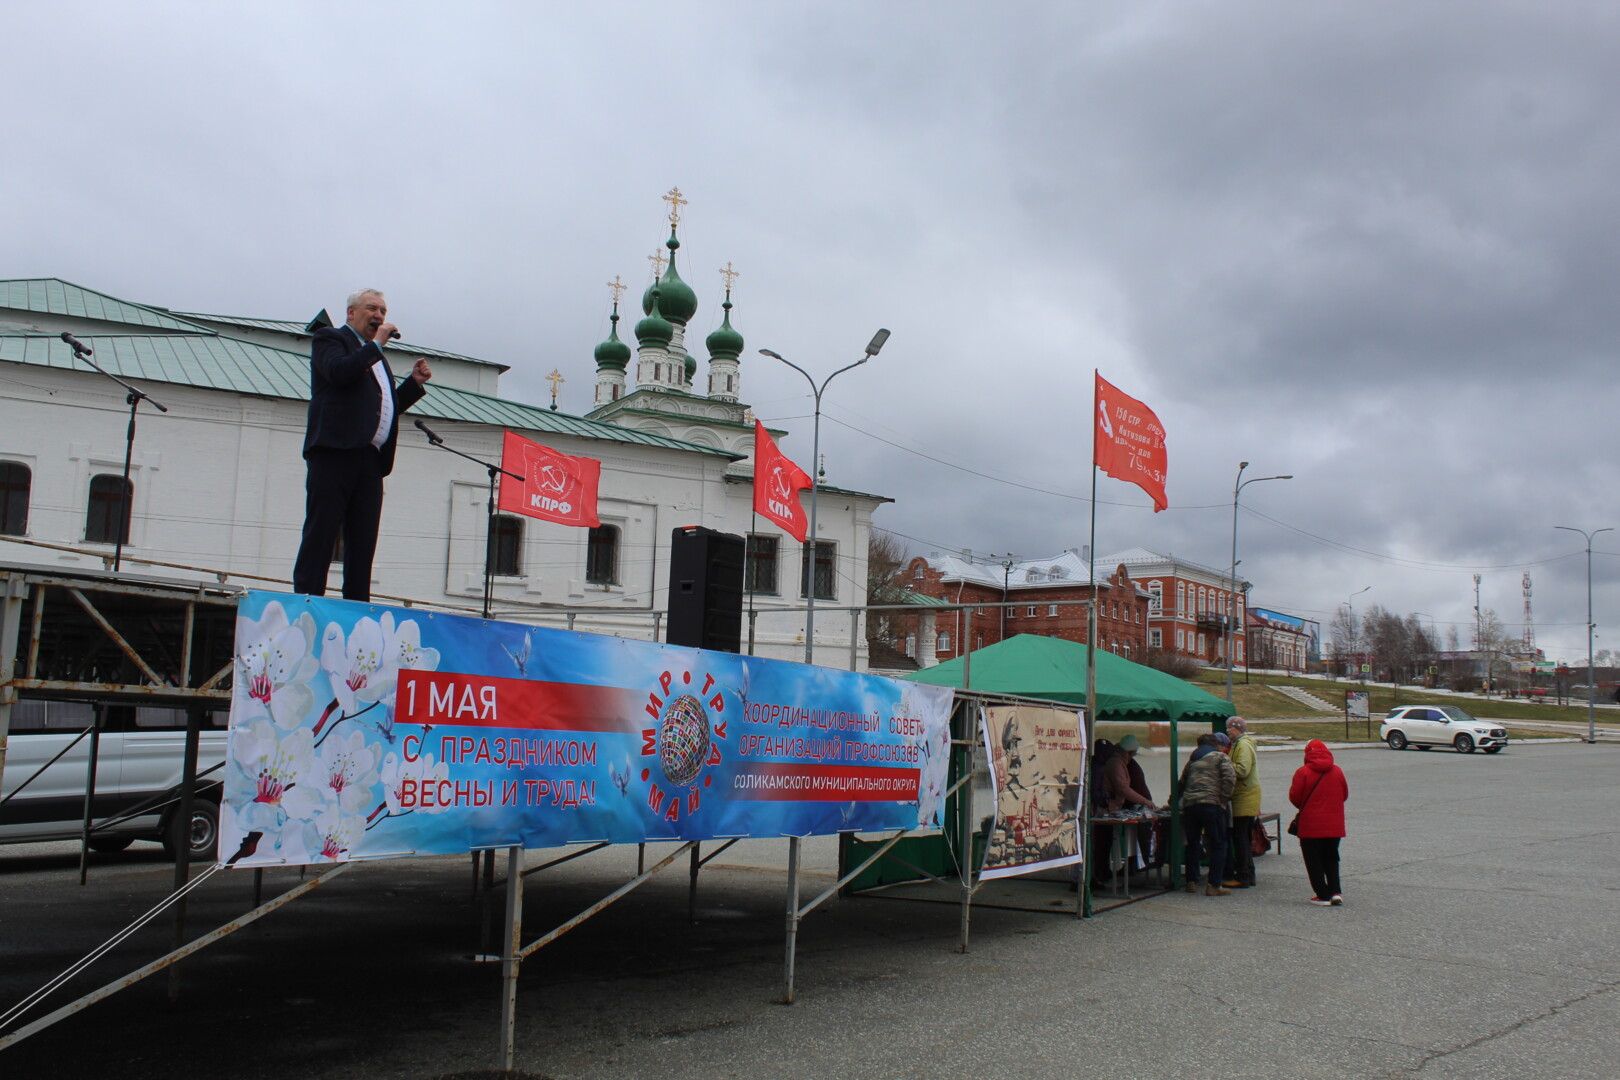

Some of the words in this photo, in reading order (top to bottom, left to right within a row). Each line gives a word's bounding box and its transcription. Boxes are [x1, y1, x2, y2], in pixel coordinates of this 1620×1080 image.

[531, 493, 572, 514] КПРФ
[407, 680, 416, 716] 1
[429, 681, 497, 720] МАЯ
[641, 670, 672, 756] МИР
[701, 672, 728, 766] ТРУД
[743, 701, 880, 733] КООРДИНАЦИОННЫЙ
[889, 717, 921, 736] СОВЕТ
[403, 735, 419, 763] С
[441, 736, 597, 770] ПРАЗДНИКОМ
[739, 735, 842, 763] ОРГАНИЗАЦИЙ
[845, 741, 919, 763] ПРОФСОЮЗОВ
[400, 780, 494, 808] ВЕСНЫ
[501, 780, 518, 806] И
[524, 780, 596, 810] ТРУДА!
[734, 774, 811, 790] СОЛИКАМСКОГО
[812, 776, 891, 793] МУНИЦИПАЛЬНОГО
[892, 778, 917, 791] ОКРУГА
[648, 783, 700, 822] МАЙ
